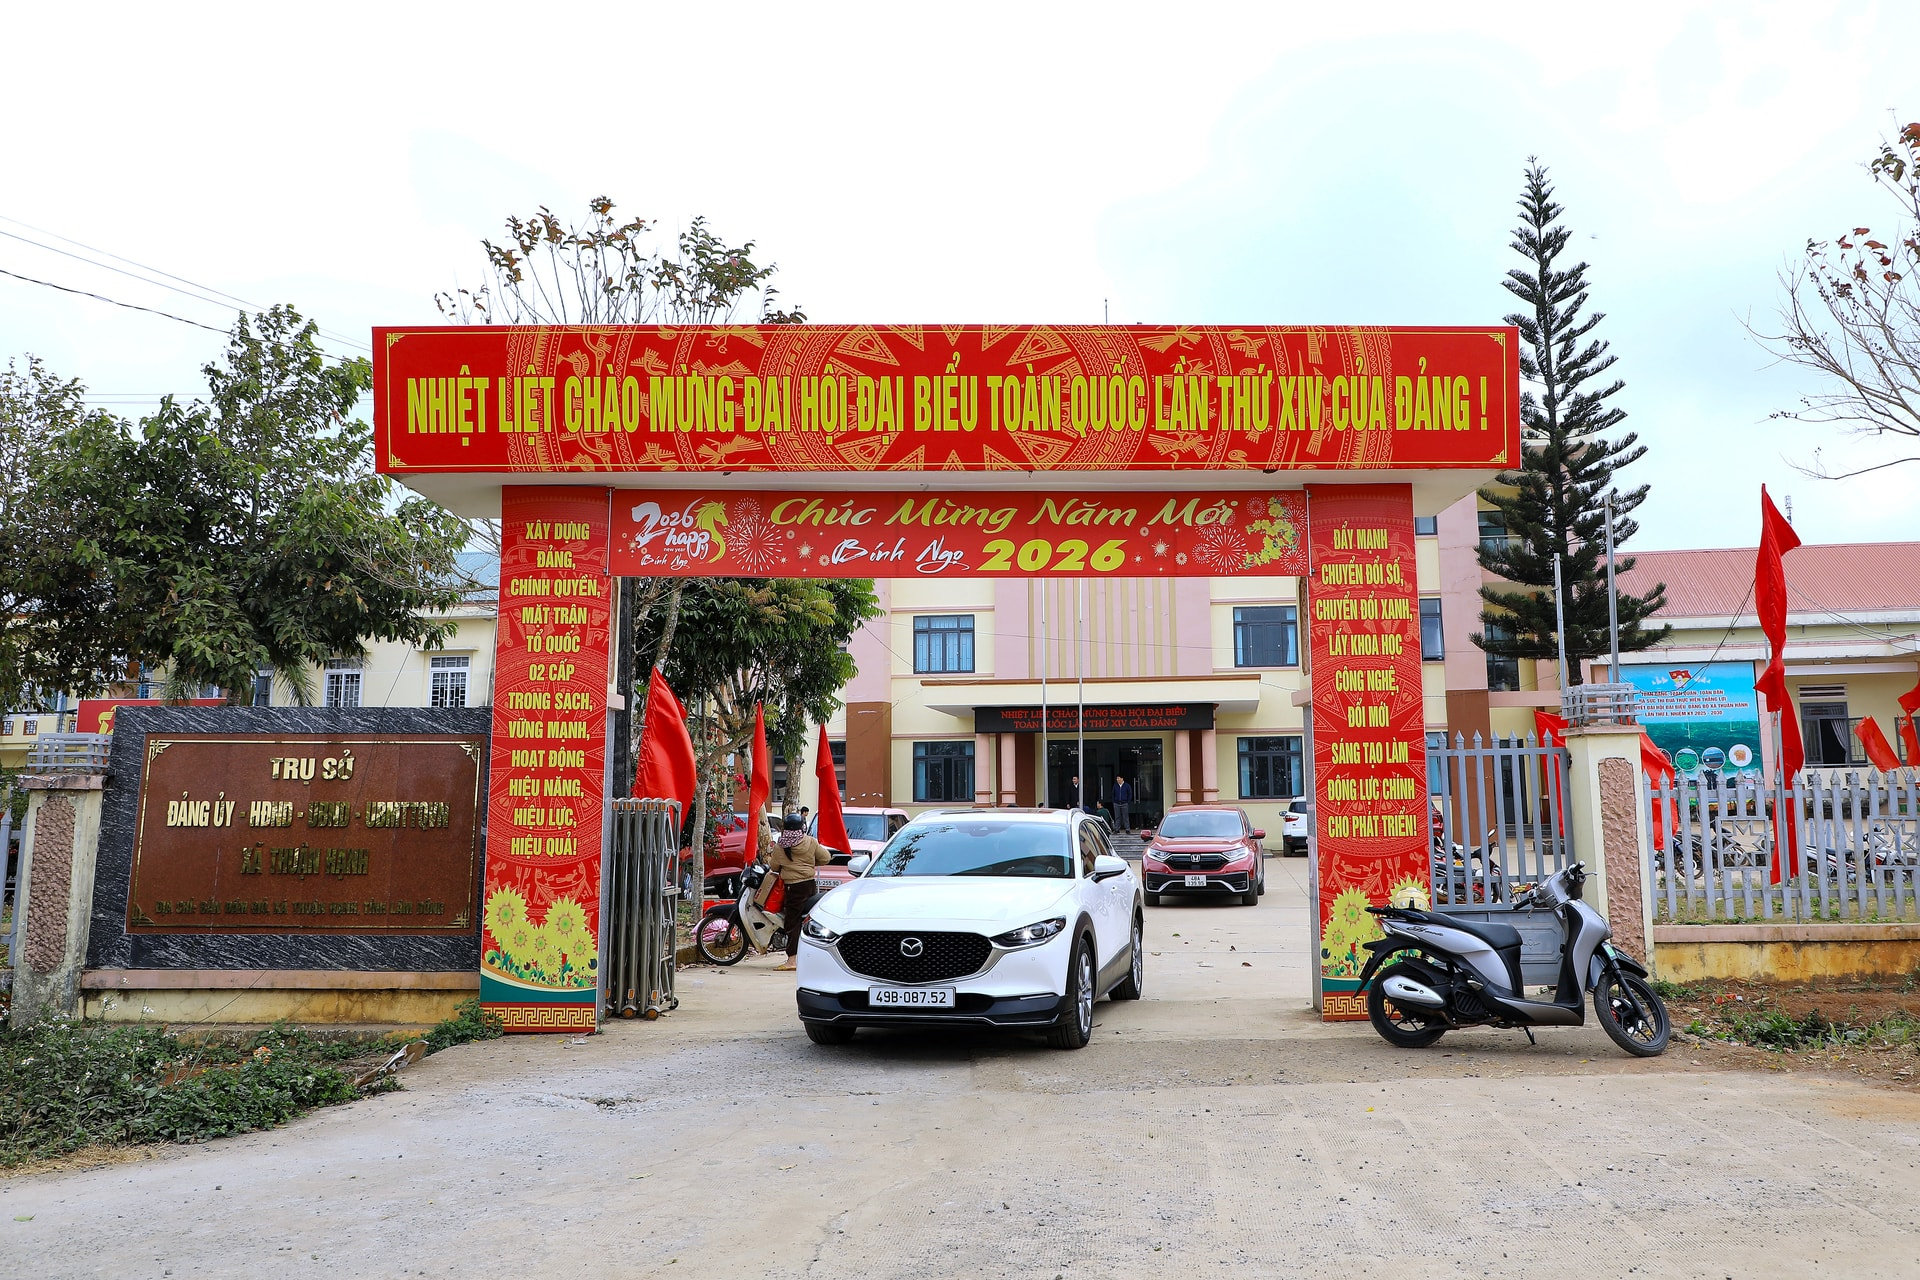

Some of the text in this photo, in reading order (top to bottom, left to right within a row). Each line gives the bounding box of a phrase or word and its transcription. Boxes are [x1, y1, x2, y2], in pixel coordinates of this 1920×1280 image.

[407, 351, 1488, 447] NHIỆT LIỆT CHÀO MỪNG ĐẠI HỘI ĐẠI BIỂU TOÀN QUỐC LẦN THỨ XIV CỦA ĐẢNG !
[632, 496, 705, 549] 2026
[770, 497, 1239, 534] Chúc Mừng Năm Mới
[525, 520, 590, 544] XÂY DỰNG
[665, 528, 710, 560] happy
[1333, 521, 1388, 554] ĐẨY MẠNH
[537, 545, 576, 569] ĐẢNG,
[831, 537, 905, 565] Bính
[976, 539, 1129, 572] 2026
[510, 574, 600, 597] CHÍNH QUYỀN,
[1321, 555, 1404, 586] CHUYỂN ĐỔI SỐ,
[522, 604, 587, 628] MẶT TRẬN
[1316, 591, 1413, 622] CHUYỂN ĐỔI XANH,
[526, 629, 580, 654] TỔ QUỐC
[1329, 627, 1403, 660] LẤY KHOA HỌC
[529, 659, 575, 681] 02 CẤP
[1335, 666, 1399, 696] CÔNG NGHỆ,
[508, 692, 593, 713] TRONG SẠCH,
[1348, 698, 1390, 728] ĐỔI MỚI
[508, 718, 590, 742] VỮNG MẠNH,
[1111, 719, 1127, 727] XIV
[270, 749, 356, 785] TRỤ SỞ
[511, 747, 585, 771] HOẠT ĐỘNG
[1331, 737, 1409, 768] SÁNG TẠO LÀM
[509, 776, 584, 800] HIỆU NĂNG,
[1328, 773, 1415, 805] ĐỘNG LỰC CHÍNH
[167, 791, 211, 827] ĐẢNG
[213, 791, 236, 827] ỦY
[249, 801, 293, 827] HĐND
[307, 801, 350, 828] UBND
[365, 801, 450, 831] UBMTTQVN
[514, 805, 577, 829] HIỆU LỰC,
[1328, 806, 1418, 838] CHO PHÁT TRIỂN!
[240, 841, 369, 880] XÃ THUẬN HẠNH
[510, 832, 577, 859] HIỆU QUẢ!
[876, 990, 947, 1005] 49B-087.52
